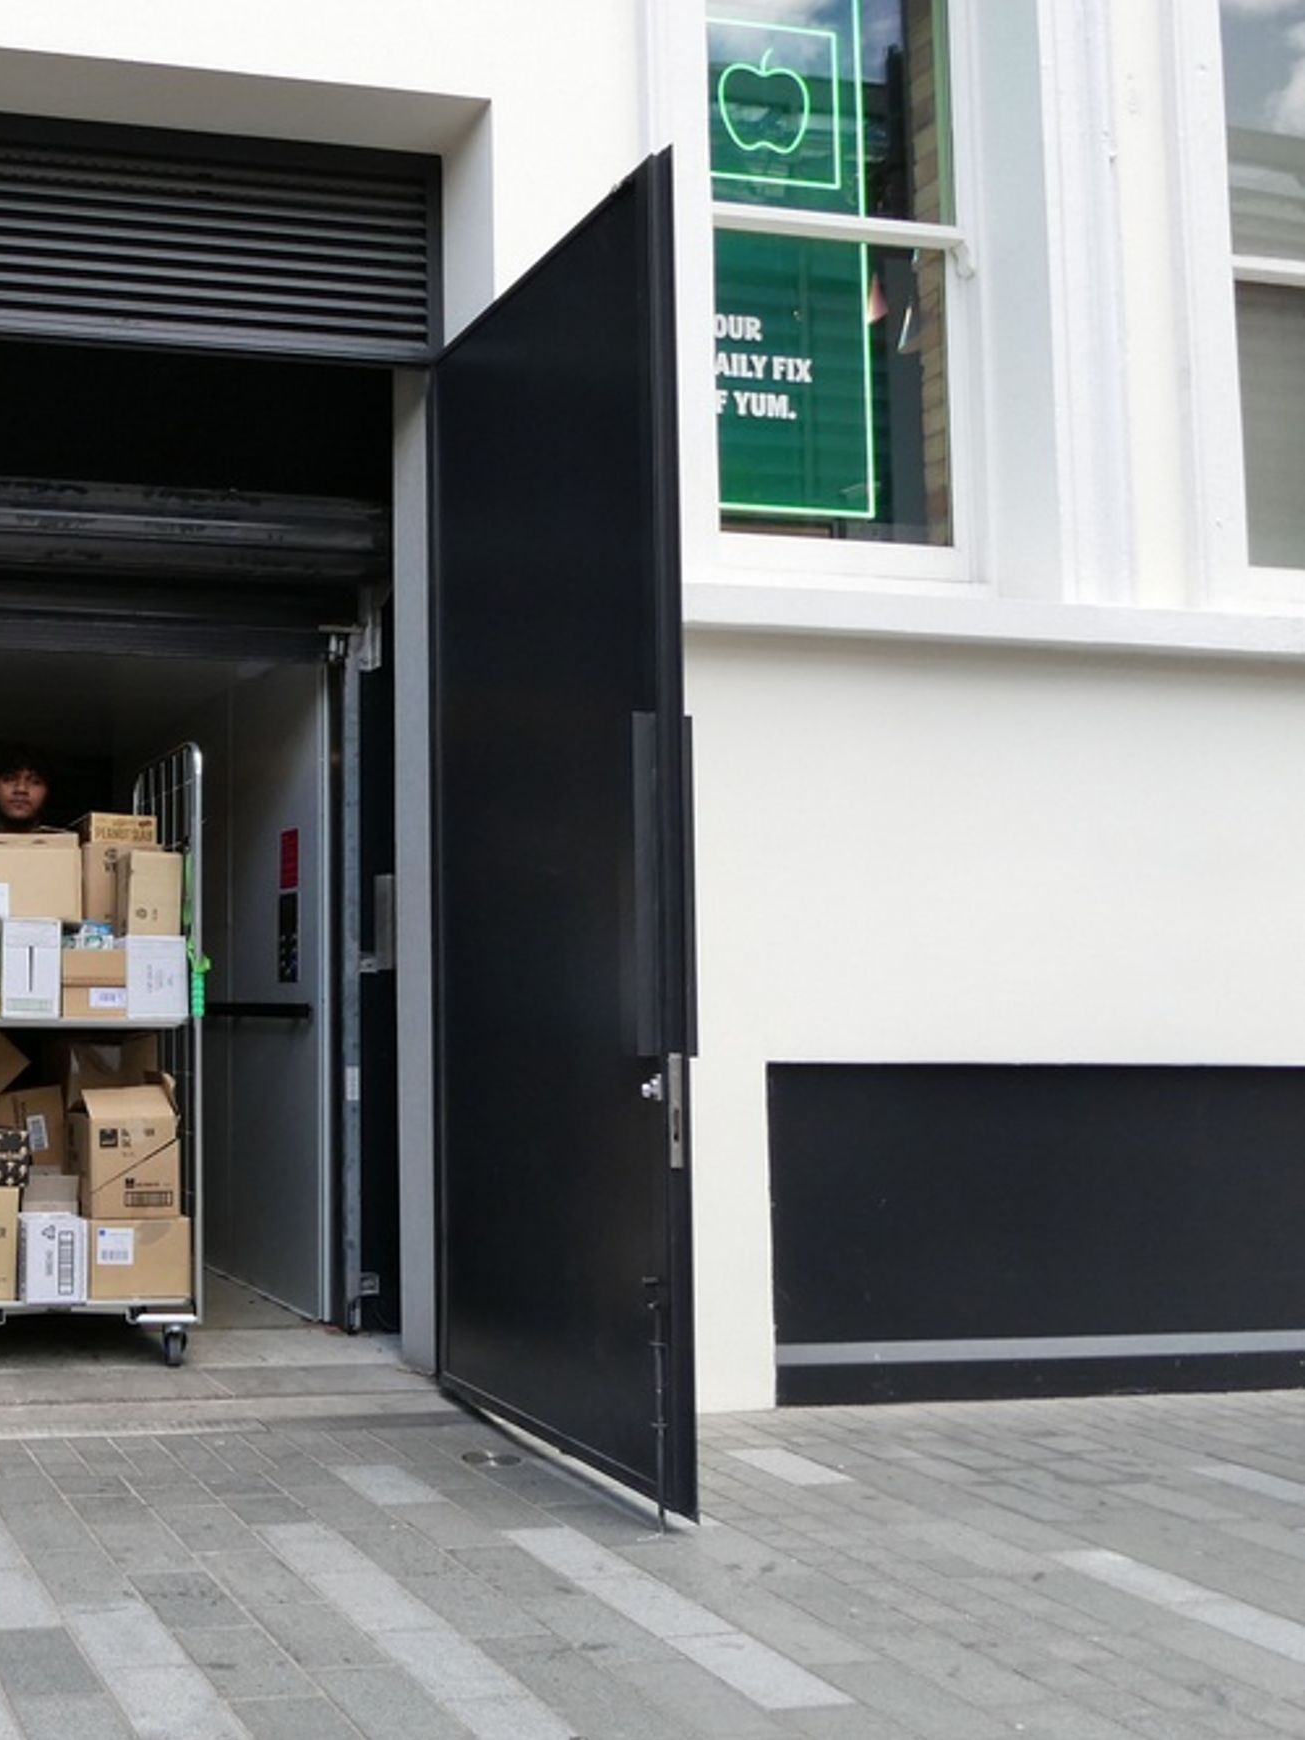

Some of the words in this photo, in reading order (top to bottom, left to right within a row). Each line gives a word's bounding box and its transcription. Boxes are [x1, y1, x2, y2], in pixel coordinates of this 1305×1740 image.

[714, 313, 762, 341] OUR
[715, 351, 768, 379] AILY
[772, 355, 813, 383] FIX
[716, 389, 728, 414] F
[733, 389, 797, 419] YUM.
